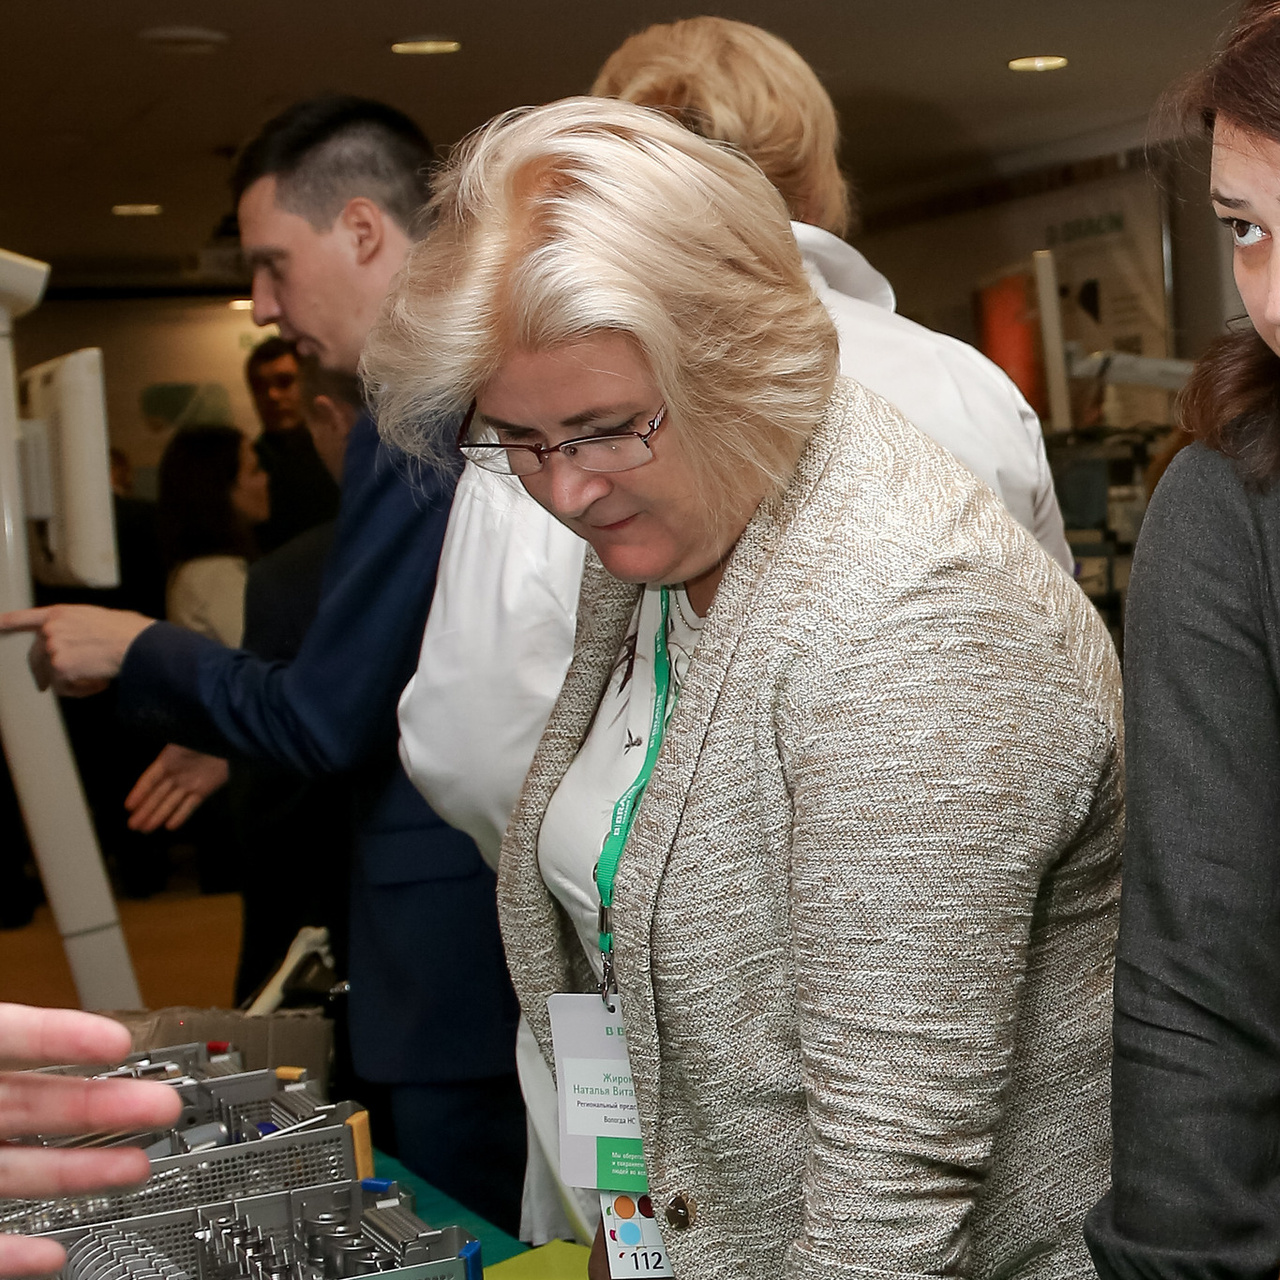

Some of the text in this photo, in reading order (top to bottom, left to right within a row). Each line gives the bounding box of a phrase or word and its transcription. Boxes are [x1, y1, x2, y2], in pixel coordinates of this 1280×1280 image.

[573, 1084, 611, 1096] Наталья
[576, 1100, 618, 1110] Региональный
[603, 1115, 626, 1125] Вологда
[611, 1151, 621, 1159] Мы
[630, 1251, 665, 1271] 112
